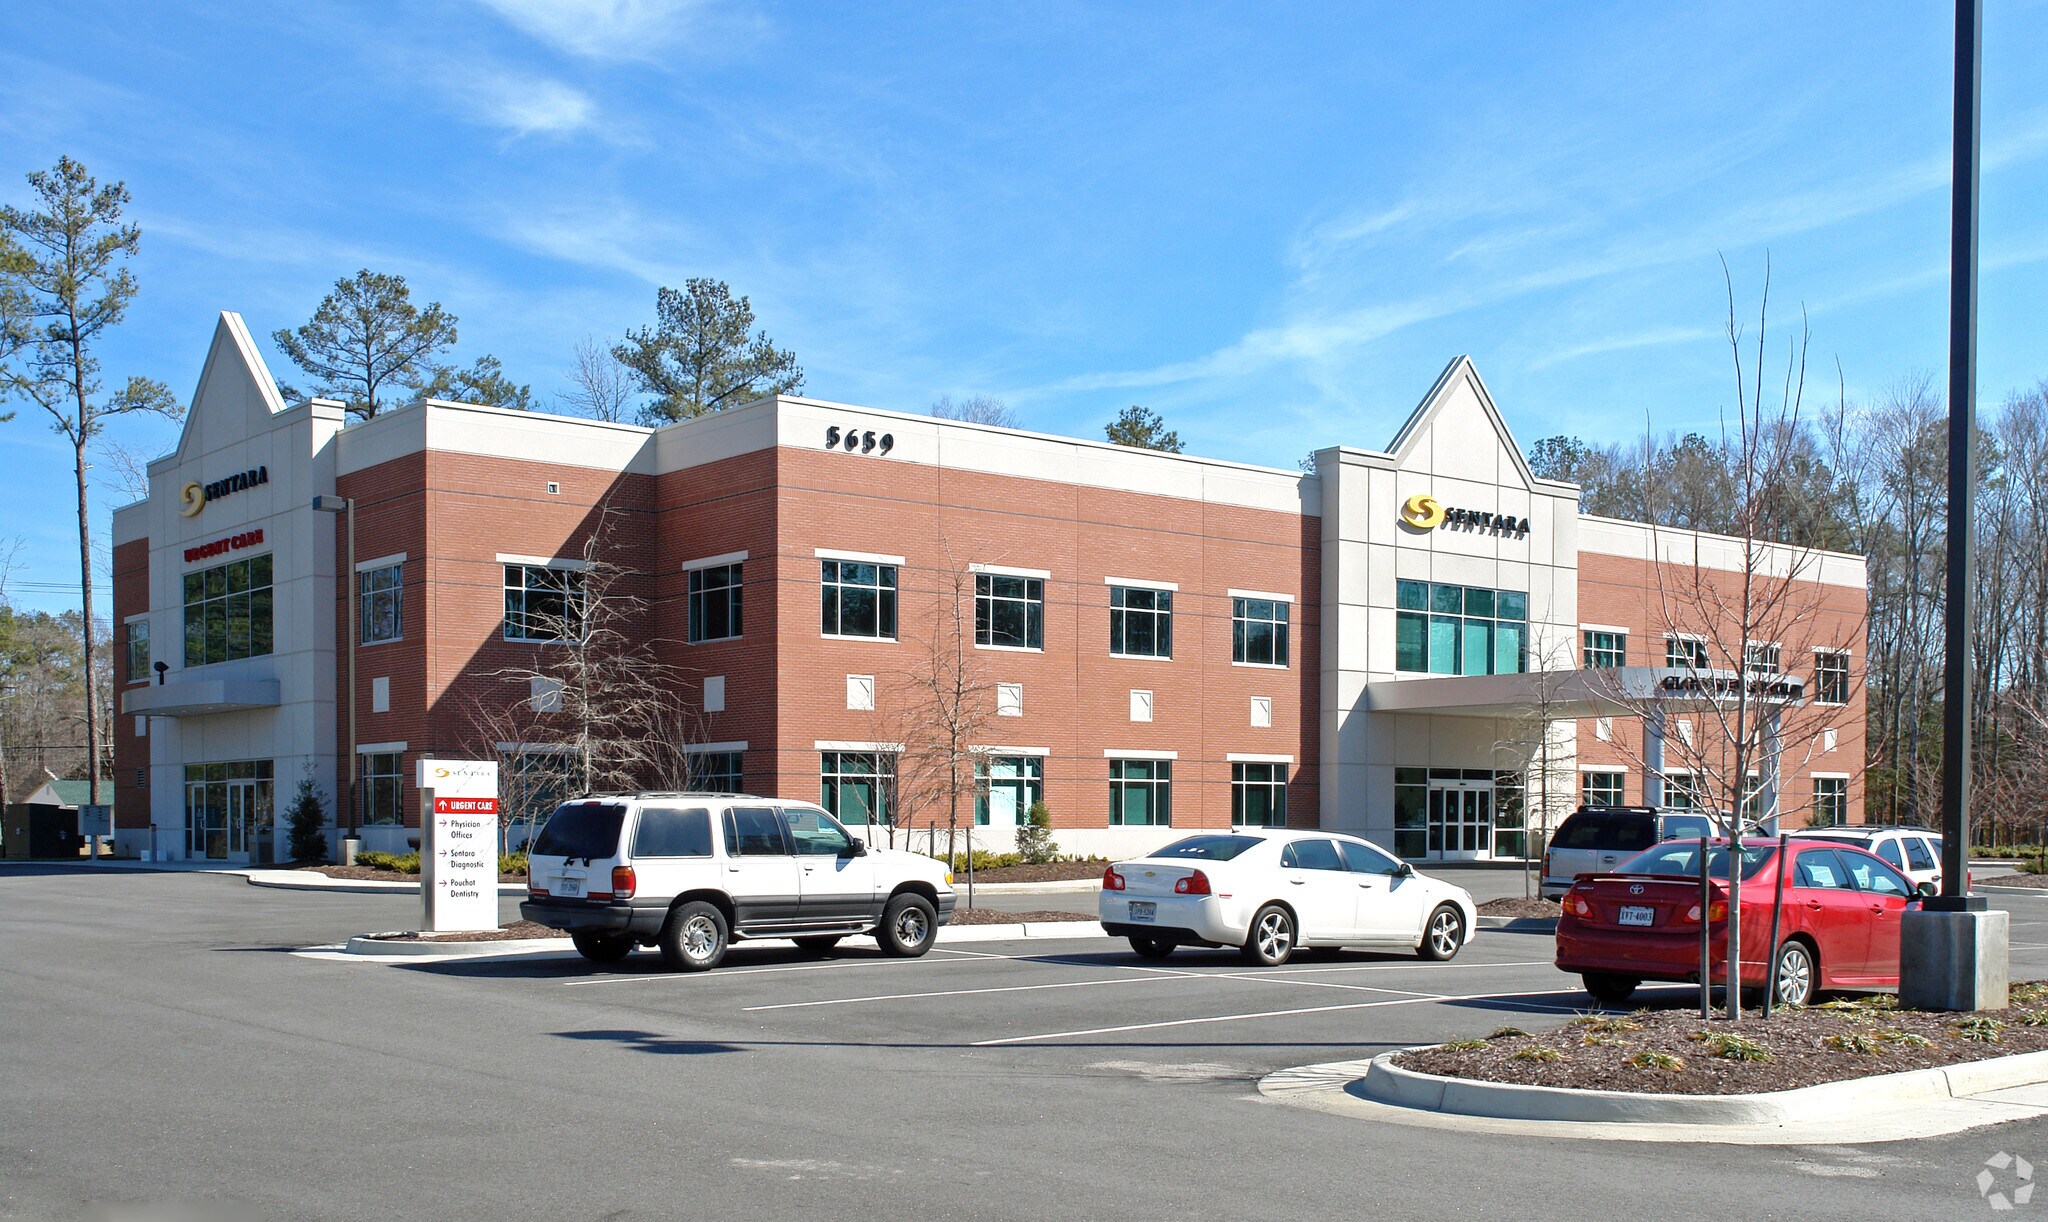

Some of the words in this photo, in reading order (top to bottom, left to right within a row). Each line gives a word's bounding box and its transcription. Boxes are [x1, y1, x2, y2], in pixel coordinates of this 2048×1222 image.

[826, 425, 894, 456] 5659
[204, 465, 269, 501] SENTARA
[1442, 507, 1531, 536] SENTARA
[450, 800, 477, 811] URGENT
[477, 801, 493, 811] CARE
[450, 819, 481, 829] Physician
[450, 830, 473, 839] Offices
[450, 848, 476, 858] Sentara
[450, 860, 484, 870] Diagnostic
[450, 878, 476, 887] Pouchot
[450, 889, 479, 899] Dentistry
